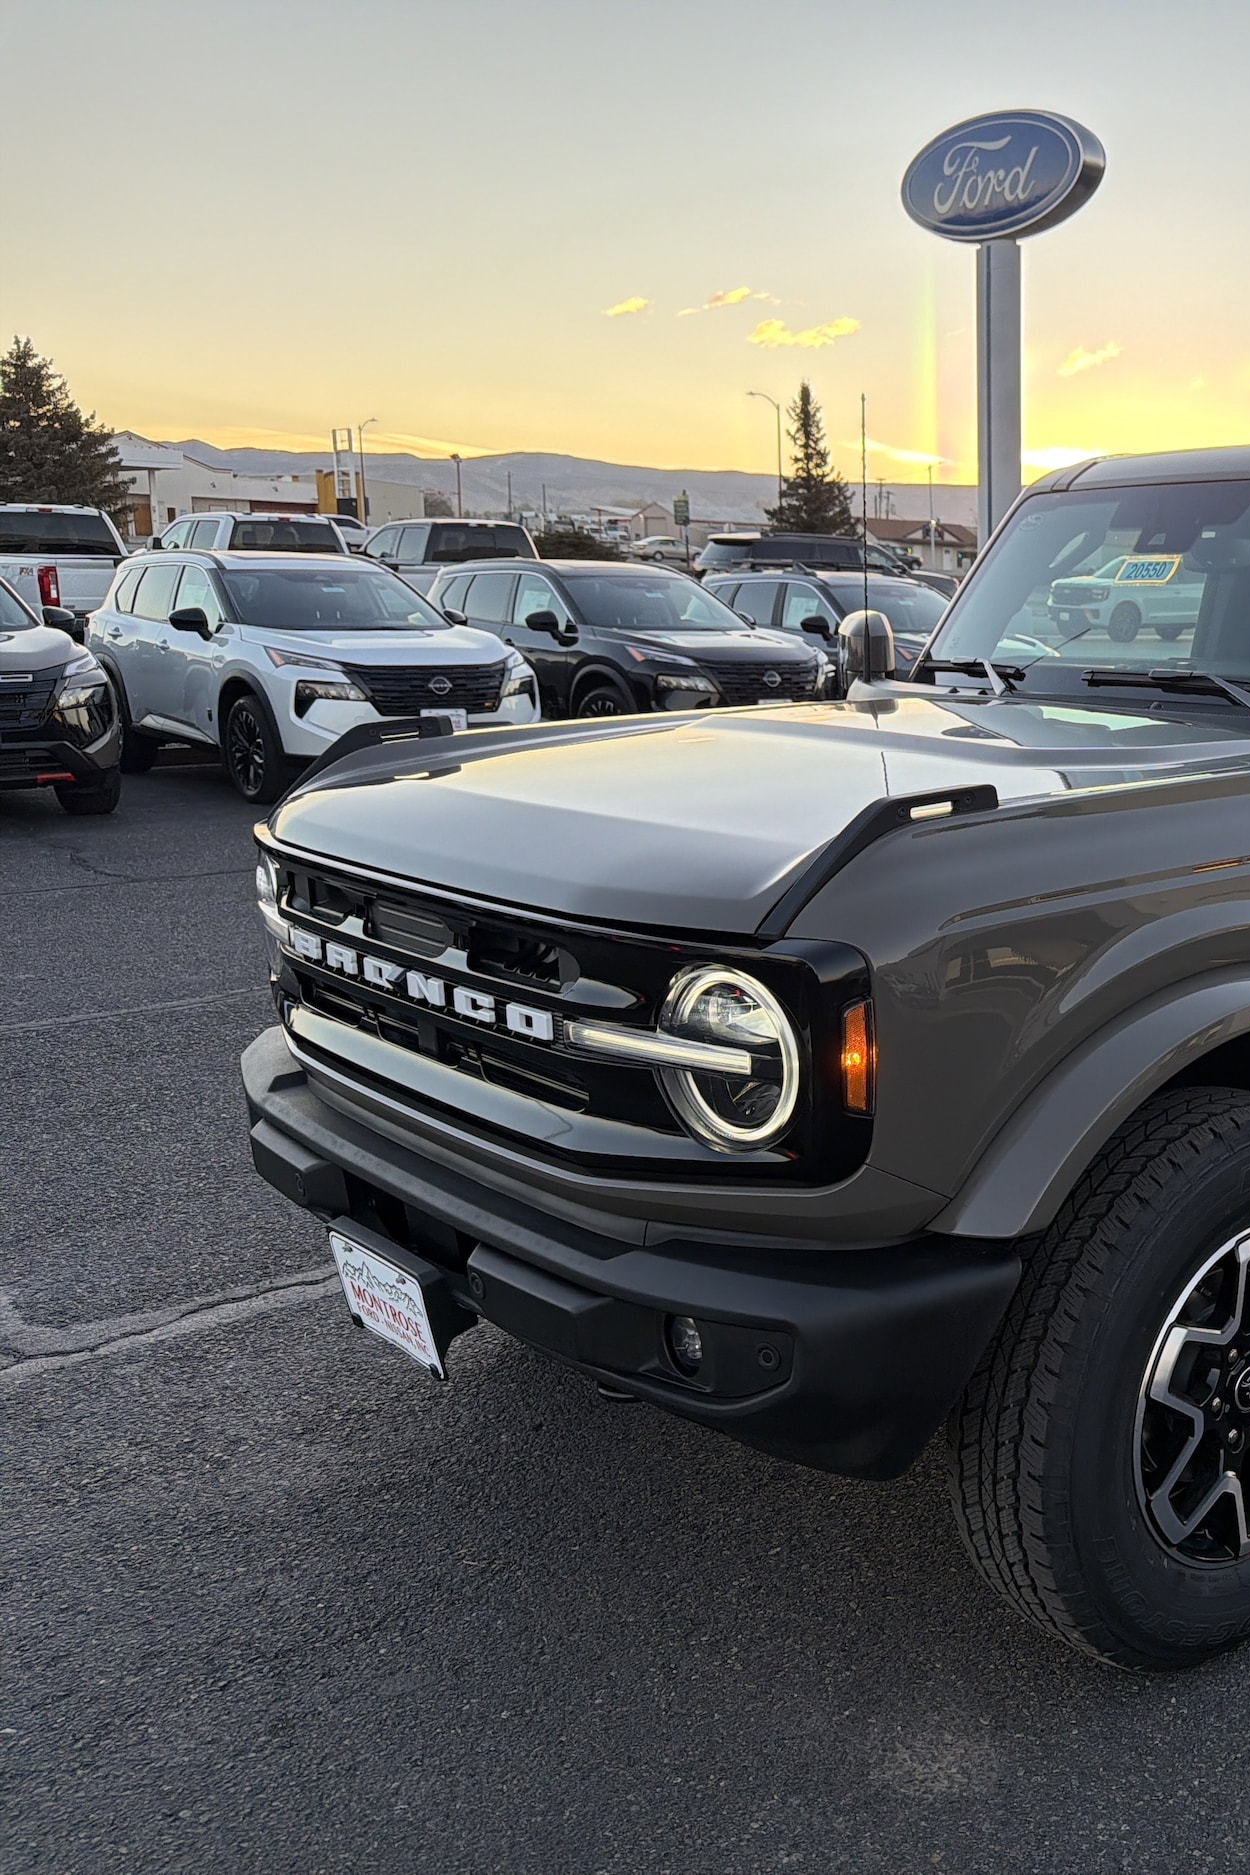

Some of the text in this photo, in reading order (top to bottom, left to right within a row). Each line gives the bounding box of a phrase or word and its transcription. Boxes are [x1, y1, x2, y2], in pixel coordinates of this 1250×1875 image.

[933, 135, 1040, 215] Ford
[1125, 561, 1168, 579] 20550
[293, 928, 556, 1042] BRONCO
[350, 1280, 427, 1344] MONTROSE
[356, 1301, 380, 1323] FORD
